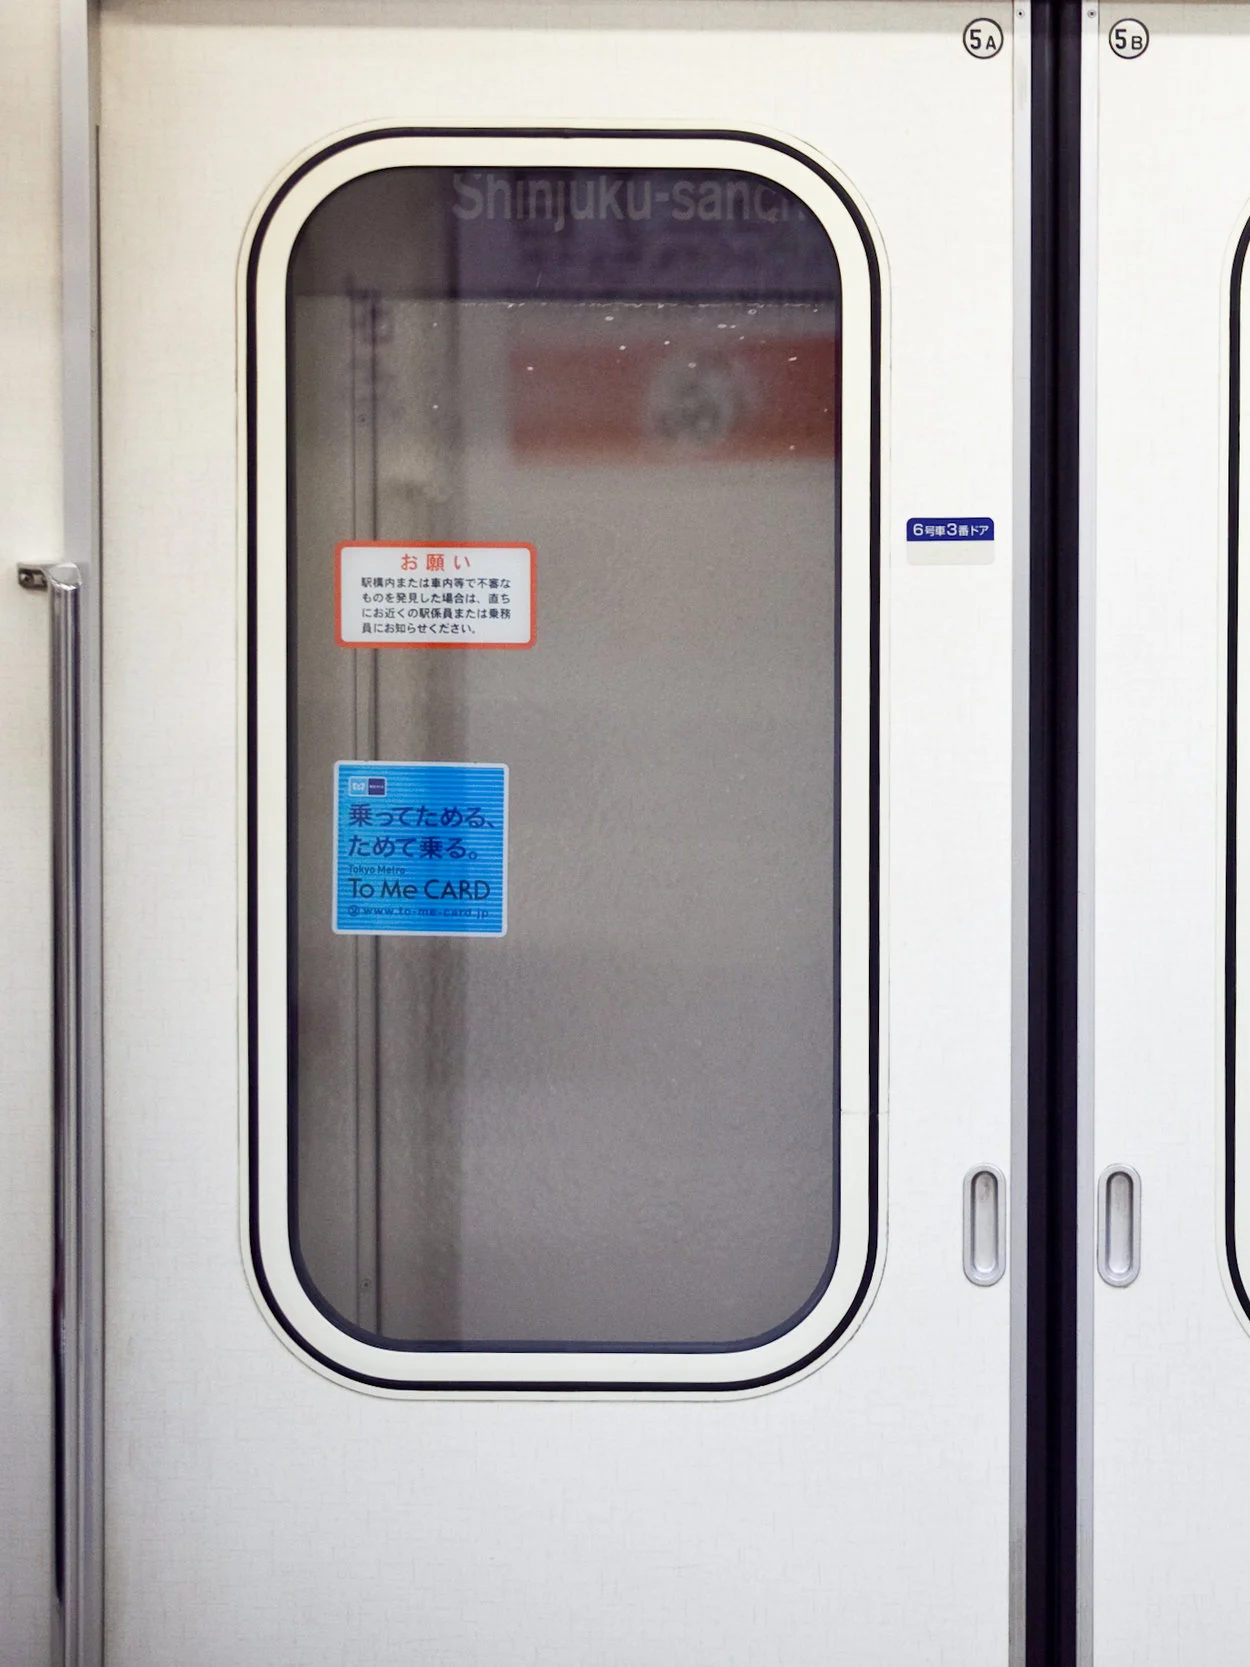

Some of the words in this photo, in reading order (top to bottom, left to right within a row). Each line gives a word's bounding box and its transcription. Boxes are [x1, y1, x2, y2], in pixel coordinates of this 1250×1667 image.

[970, 28, 996, 50] 5A
[1115, 28, 1143, 50] 5B
[913, 523, 989, 537] 6号車3番ドア
[400, 553, 471, 572] お願い
[361, 576, 511, 590] 駅構内または車内等で不審な
[362, 592, 511, 604] ものを発見した場合は、直ち
[362, 607, 511, 620] にお近くの駅係員または乗務
[362, 622, 476, 634] 員にお知らせください。
[349, 803, 495, 829] 乗ってためる、
[348, 835, 478, 860] ためて乗る。
[348, 864, 376, 876] Tokyo
[378, 865, 406, 874] Metro
[348, 878, 374, 899] To
[380, 879, 418, 899] Me
[424, 880, 491, 900] CARD
